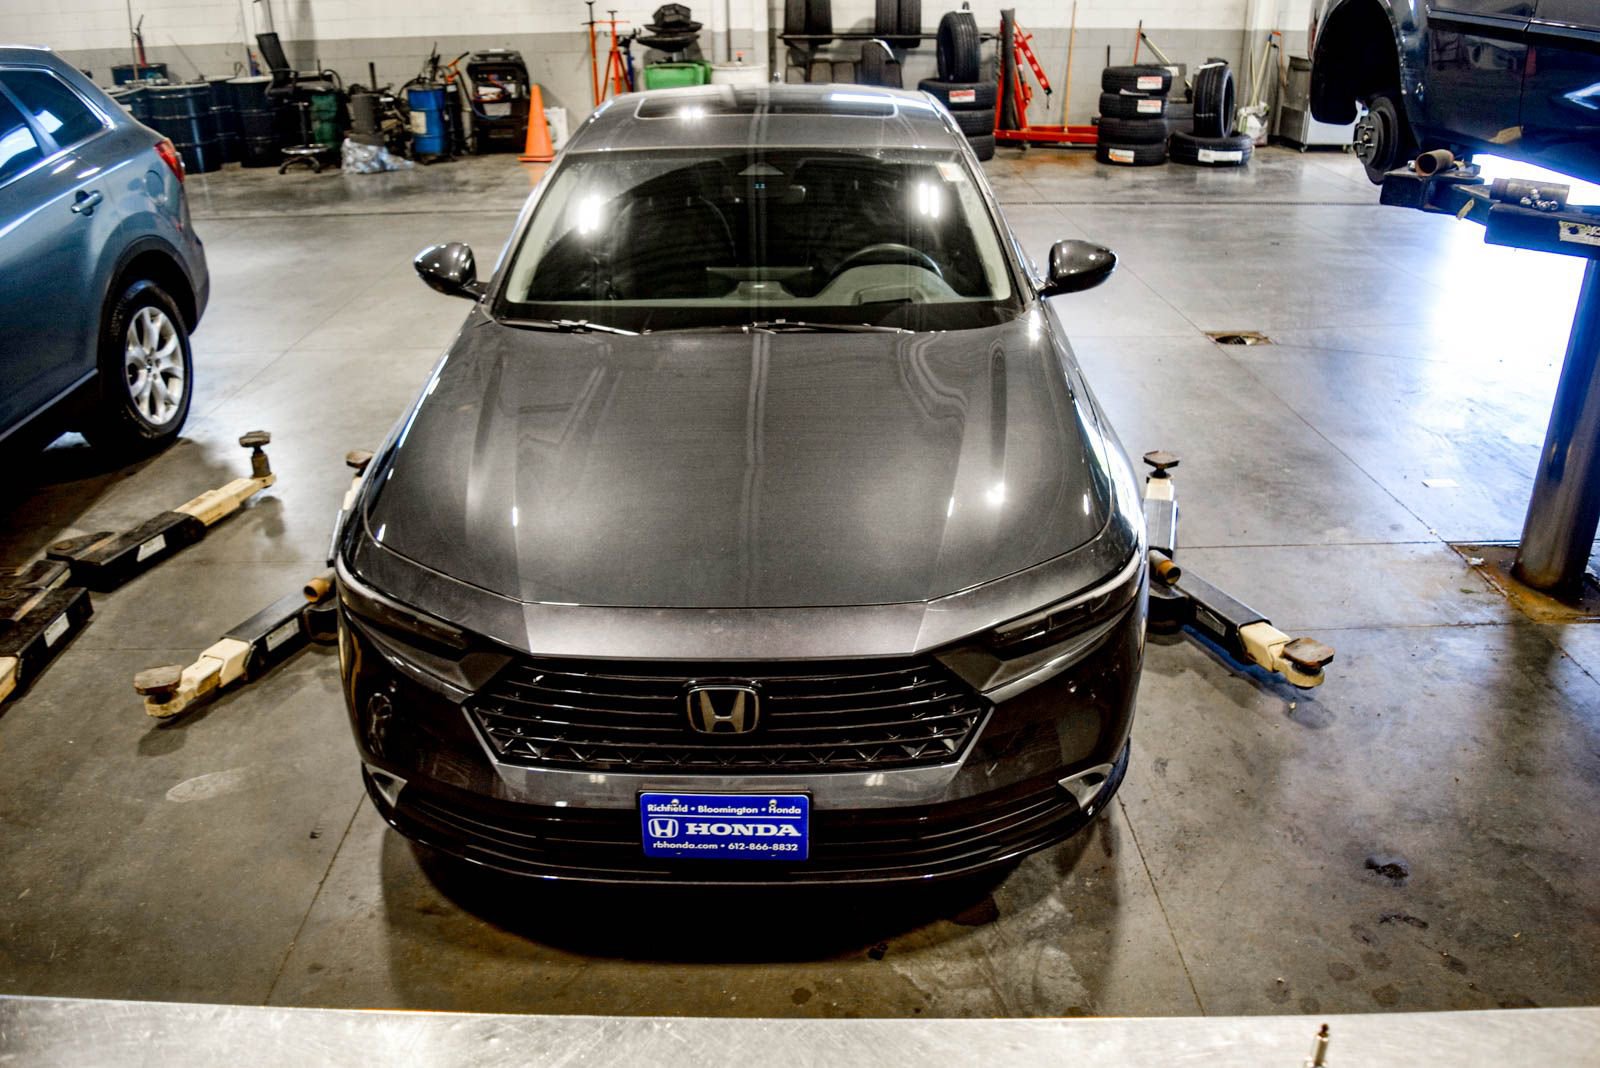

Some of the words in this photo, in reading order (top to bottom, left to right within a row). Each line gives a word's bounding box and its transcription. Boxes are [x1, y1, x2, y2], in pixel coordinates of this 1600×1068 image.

[647, 804, 688, 813] Richfield
[698, 805, 758, 815] Bloomington
[768, 805, 801, 814] Honda
[685, 823, 802, 837] HONDA
[653, 841, 718, 849] rbhonda.com
[728, 843, 799, 851] 612-866-8832
